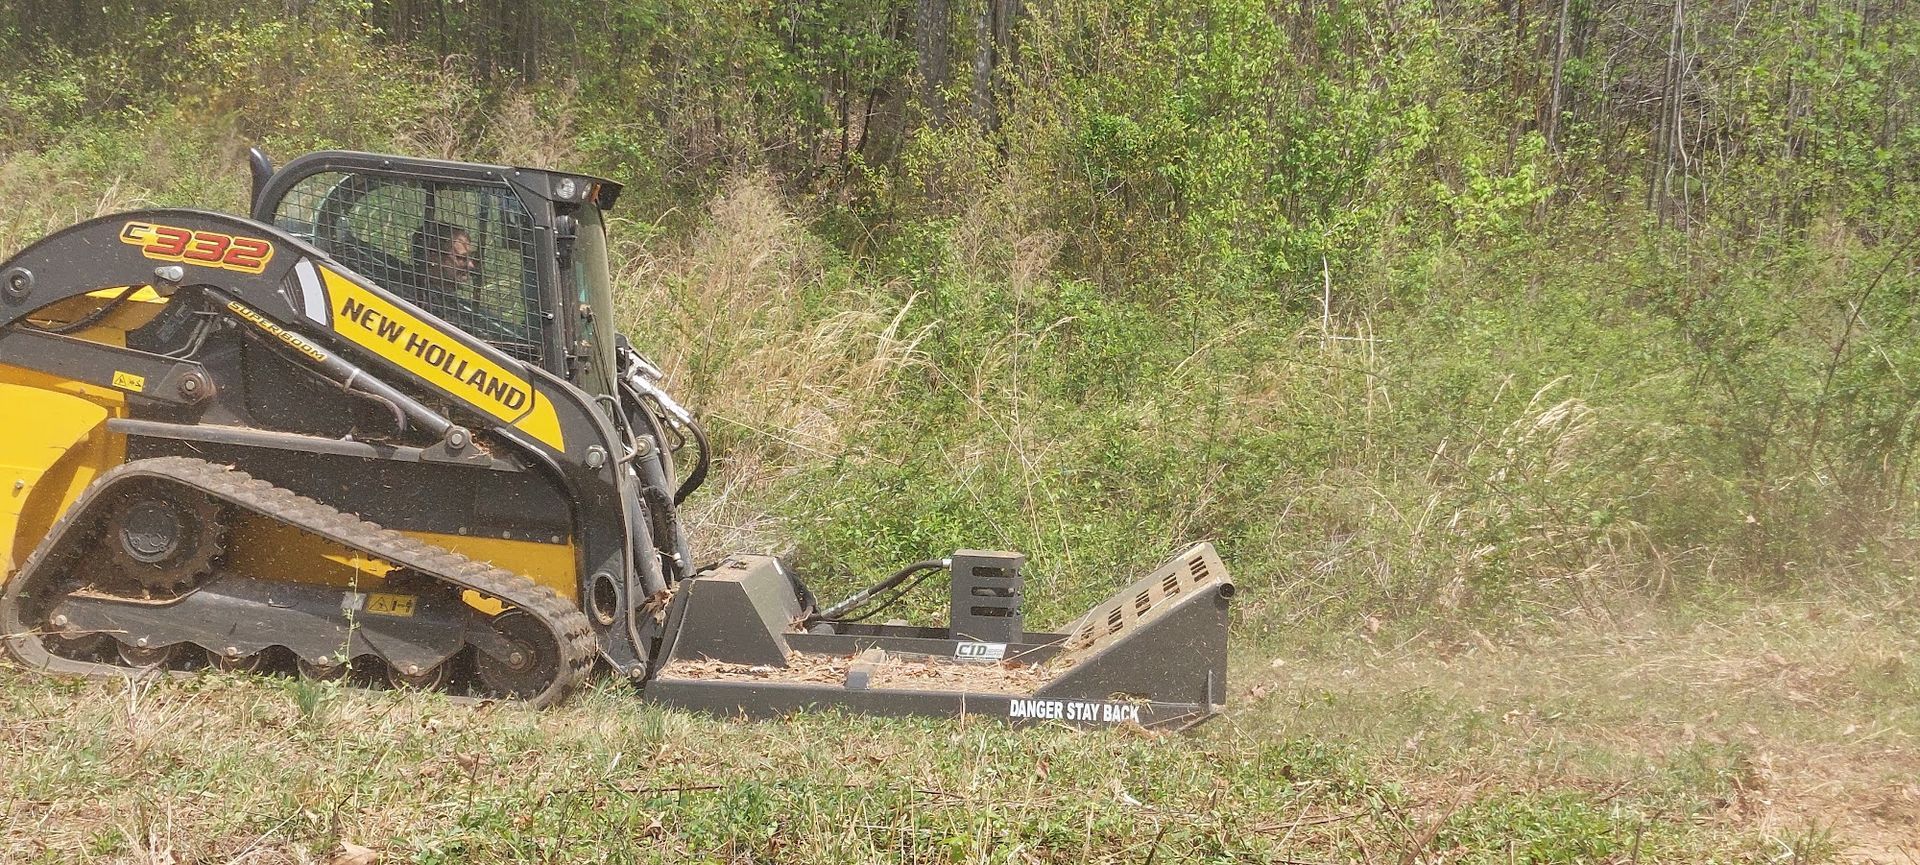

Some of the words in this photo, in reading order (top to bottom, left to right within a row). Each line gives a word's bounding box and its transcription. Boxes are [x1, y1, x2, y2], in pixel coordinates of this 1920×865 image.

[340, 297, 406, 344] NEW
[404, 332, 526, 411] HOLLAND
[957, 643, 987, 656] CID
[1010, 699, 1065, 719] DANGER
[1066, 702, 1101, 721] STAY
[1103, 703, 1140, 723] BACK
